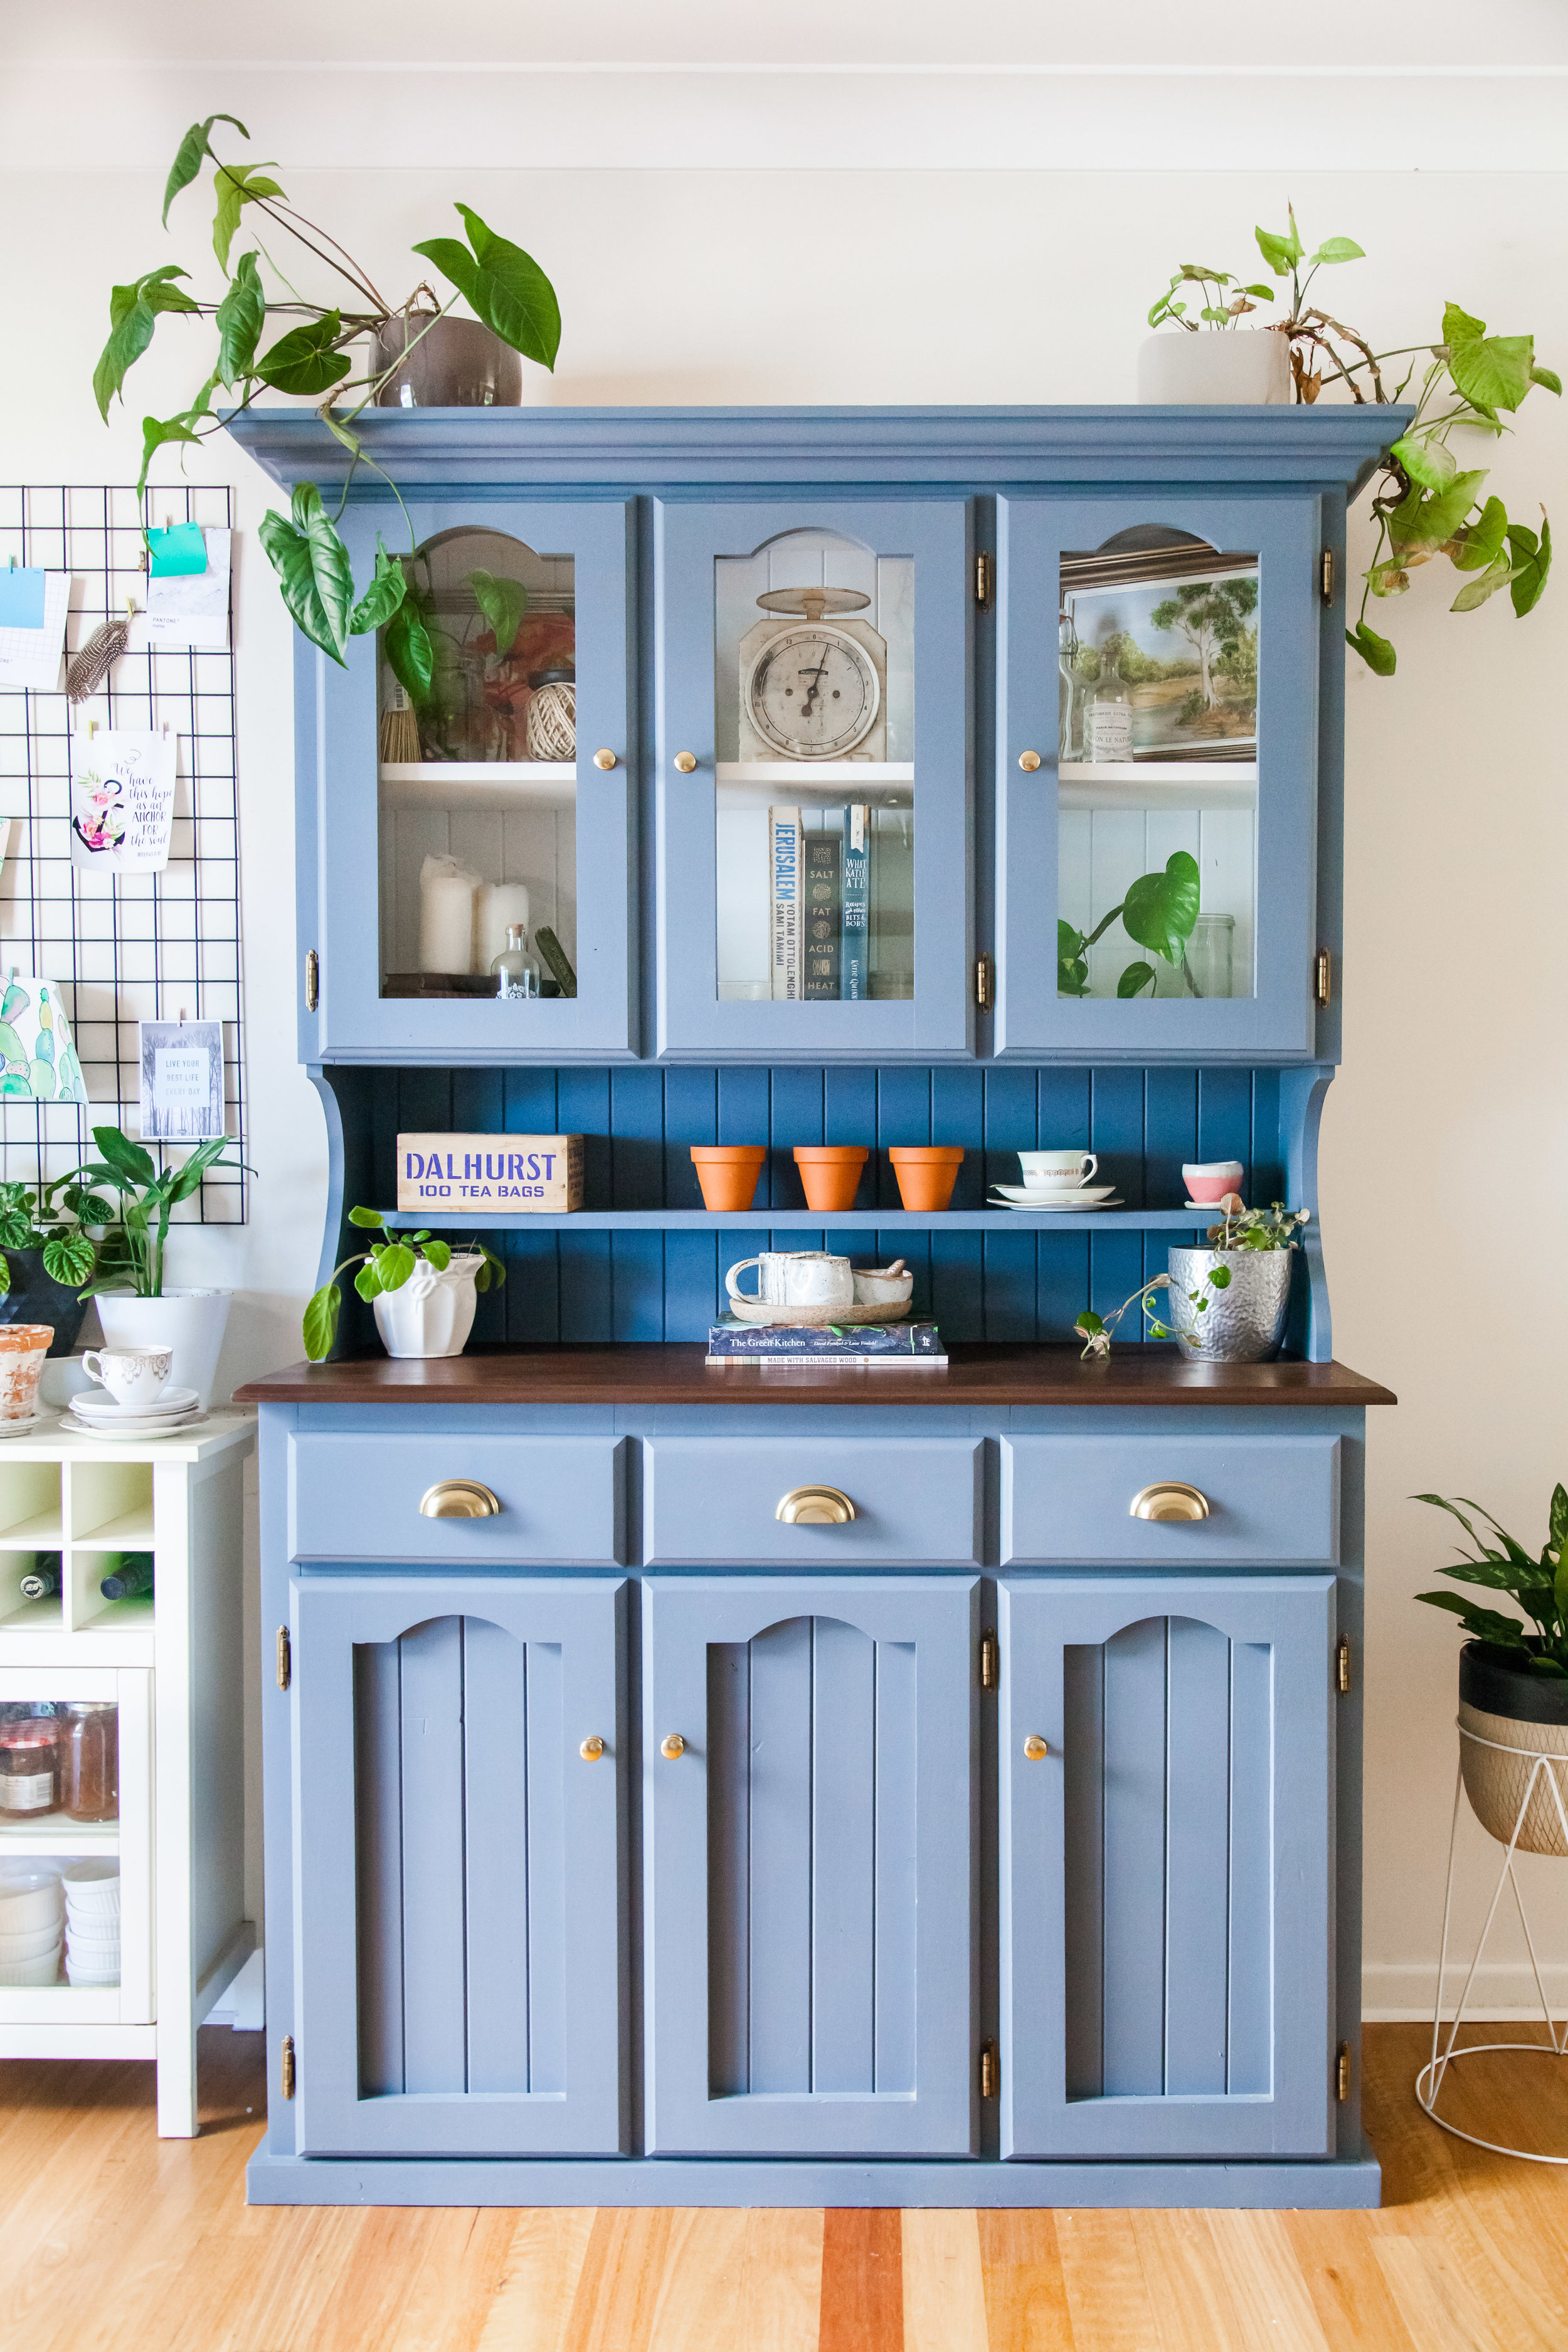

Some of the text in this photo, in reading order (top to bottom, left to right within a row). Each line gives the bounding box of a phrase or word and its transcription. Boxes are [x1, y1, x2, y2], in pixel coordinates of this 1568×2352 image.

[129, 772, 153, 787] have
[130, 785, 172, 803] this hope
[136, 802, 162, 811] as an
[132, 811, 166, 823] ANCHOR
[142, 824, 159, 835] FOR
[131, 830, 167, 847] the soul
[775, 823, 795, 899] JERUSALEM
[846, 858, 867, 869] WHAT
[845, 867, 867, 877] KATIE
[846, 877, 866, 888] ATE
[813, 908, 831, 916] FAT
[776, 903, 784, 966] SAMI TAMIMI
[787, 903, 795, 999] YOTAM OTTOLENGHI
[808, 945, 834, 953] ACID
[406, 1153, 557, 1180] DALHURST
[419, 1185, 544, 1197] 100 TEA BAGS
[729, 1338, 805, 1347] The Green Kitchen
